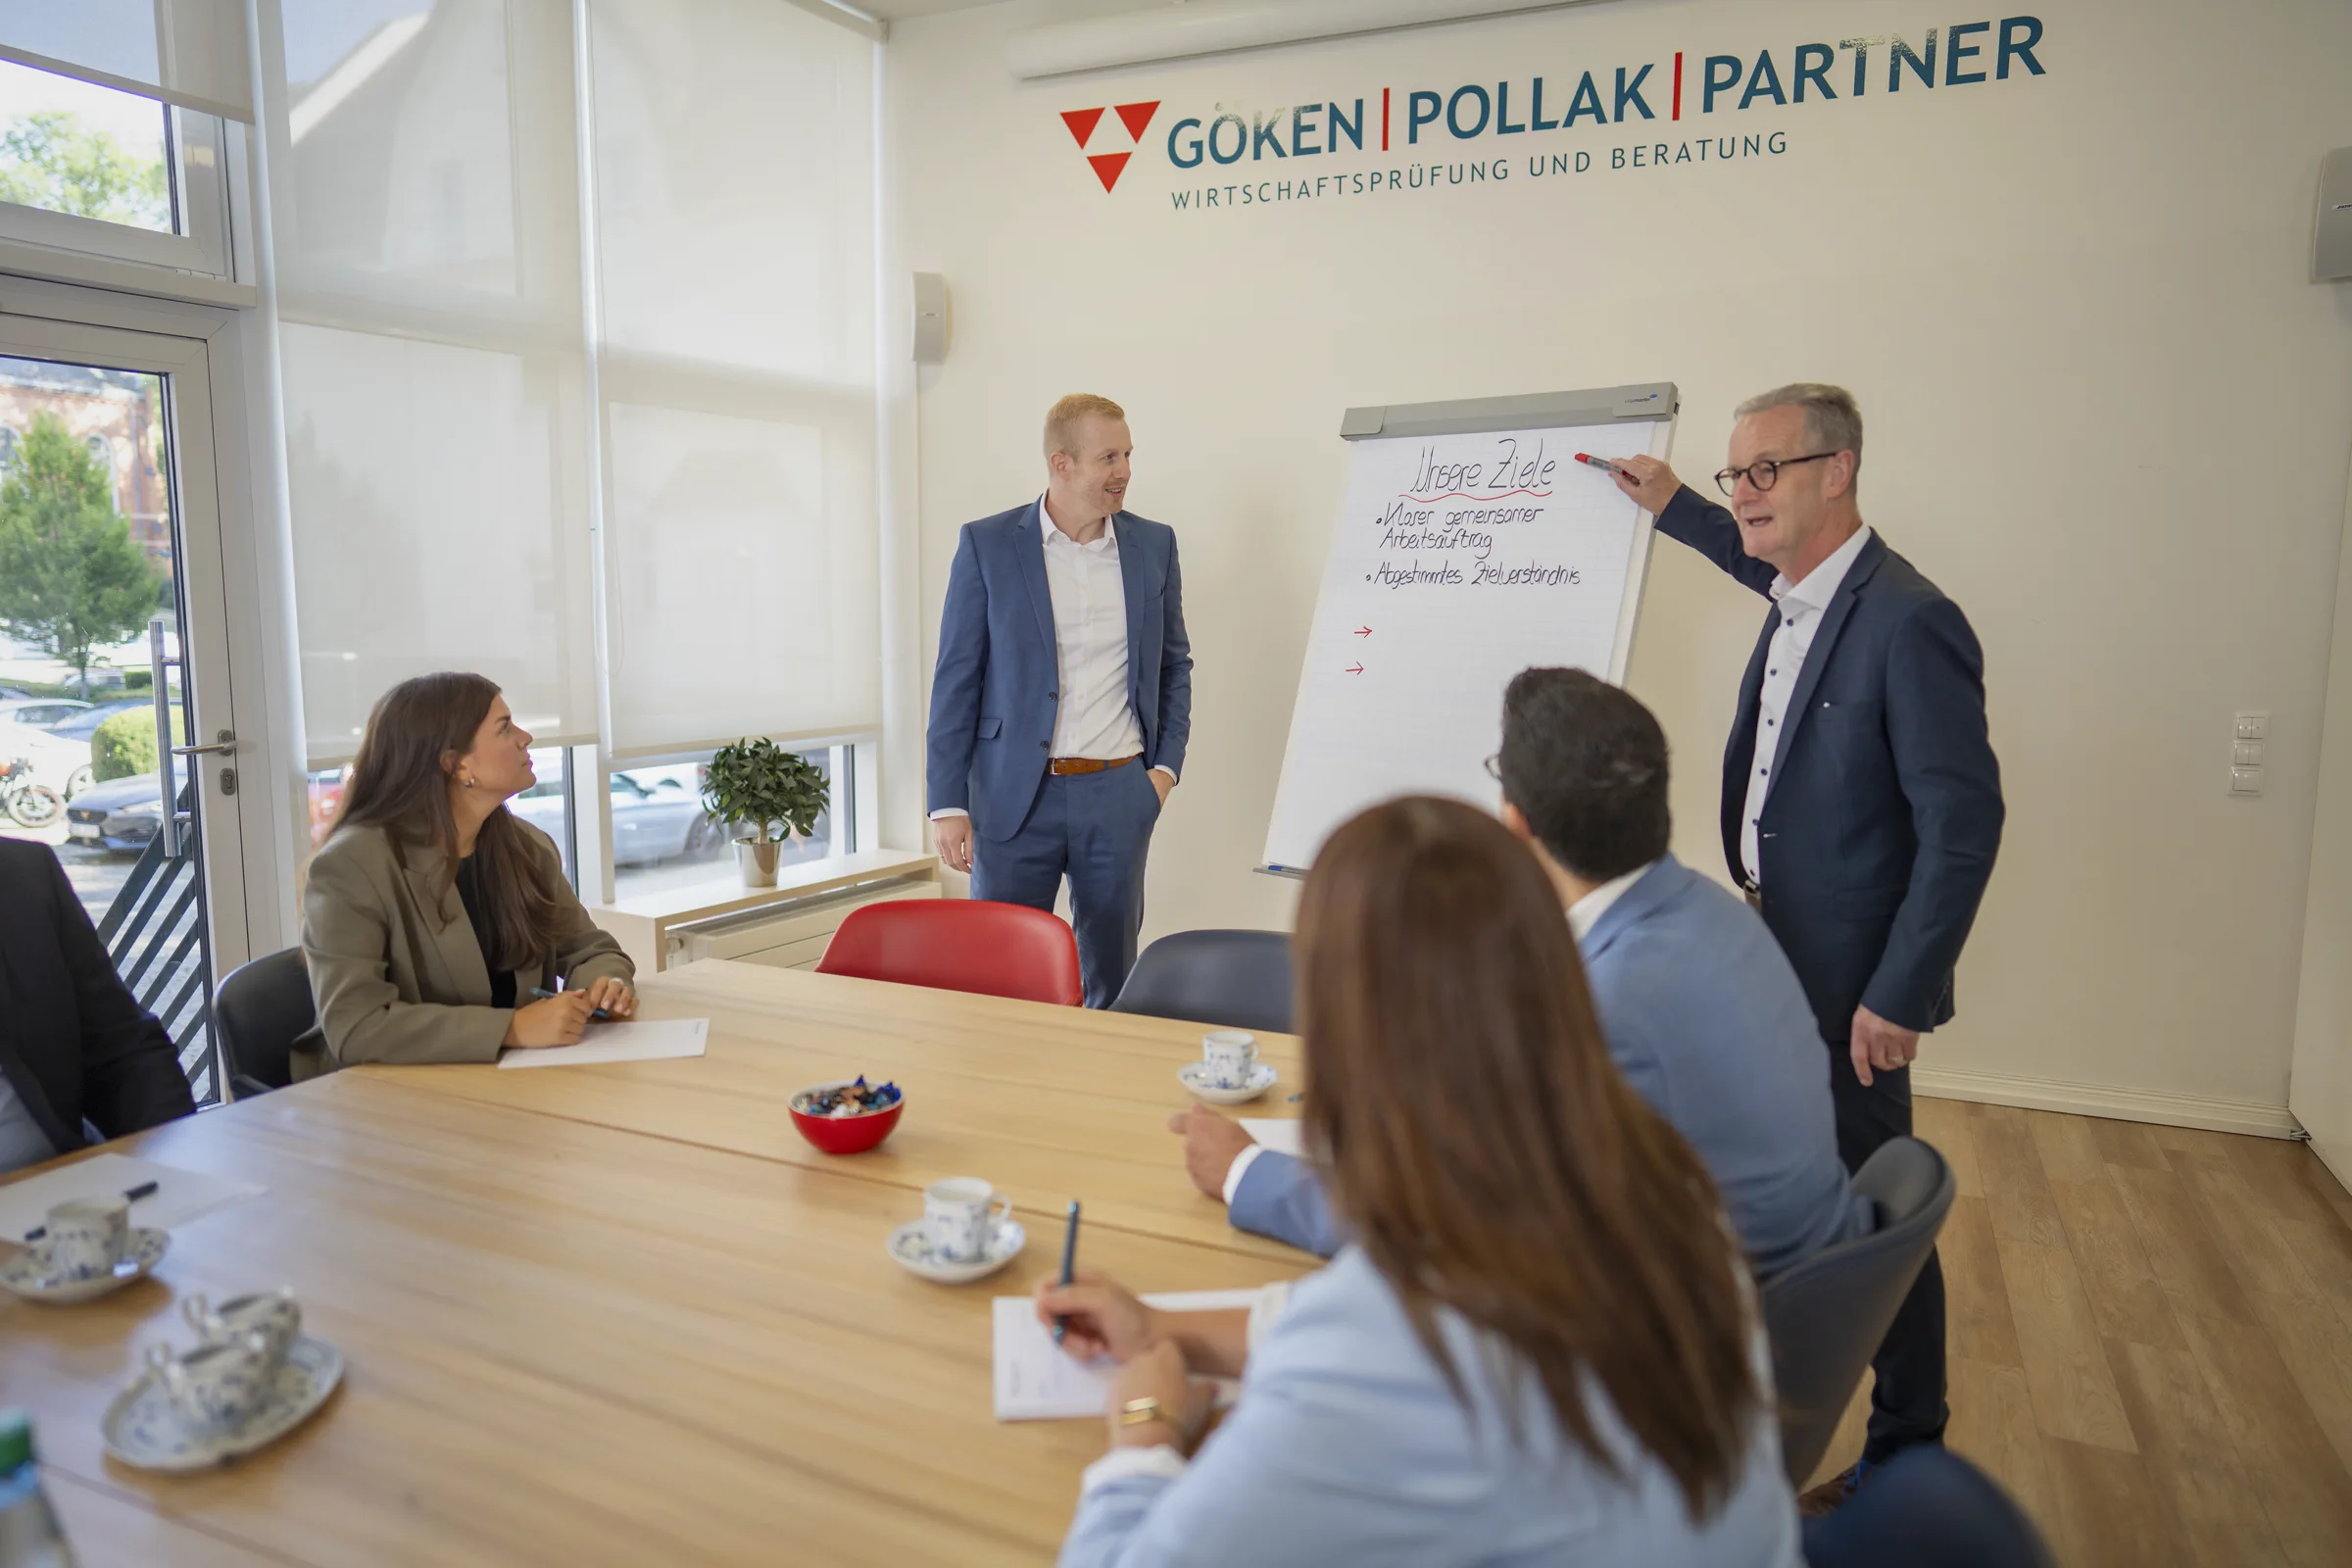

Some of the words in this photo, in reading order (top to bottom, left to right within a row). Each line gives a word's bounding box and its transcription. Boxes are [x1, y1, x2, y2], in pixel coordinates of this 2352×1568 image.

[1167, 98, 1364, 169] GÖKEN
[1407, 64, 1656, 145] POLLAK
[1702, 16, 2046, 114] PARTNER
[1171, 159, 1509, 211] WIRTSCHAFTSPRÜFUNG
[1529, 151, 1592, 177] UND
[1611, 131, 1788, 170] BERATUNG
[1410, 445, 1483, 493] Unsere
[1488, 437, 1556, 489] Ziele
[1379, 526, 1493, 560] Arbeitsauftrag
[1374, 559, 1463, 590] Abgestimmtes
